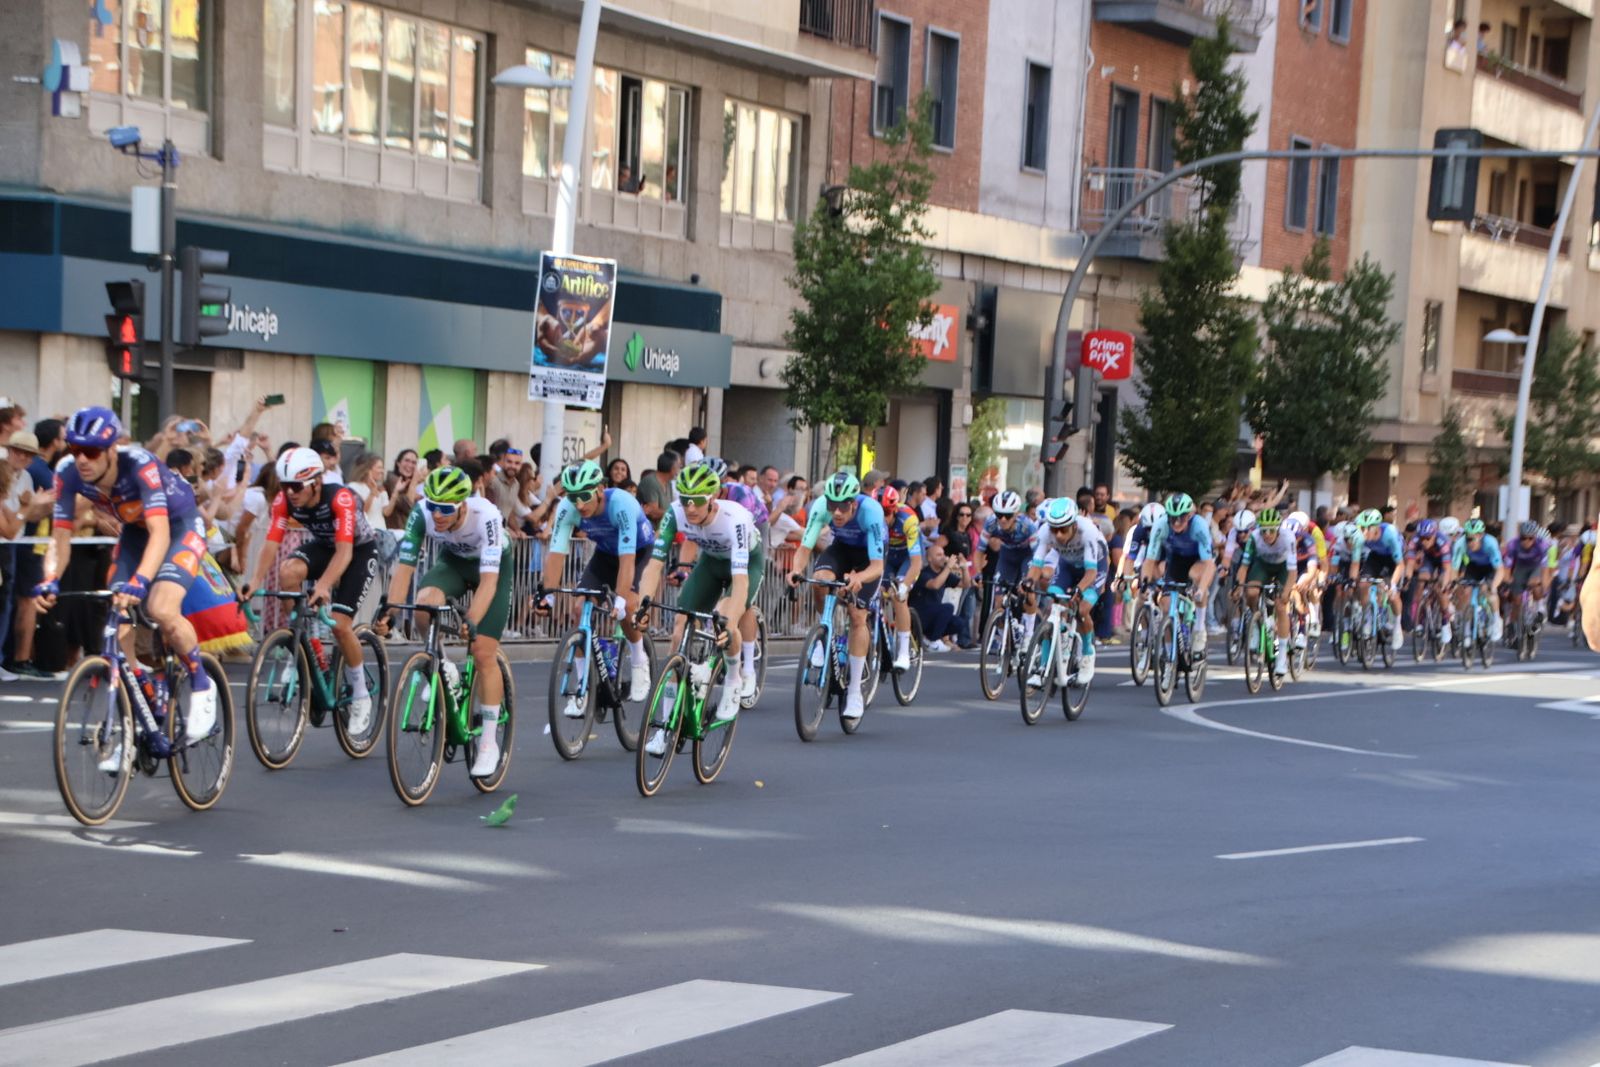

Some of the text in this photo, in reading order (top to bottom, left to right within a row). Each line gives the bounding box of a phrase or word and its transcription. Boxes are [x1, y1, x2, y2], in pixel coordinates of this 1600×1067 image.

[224, 303, 279, 341] Unicaja
[1090, 337, 1125, 351] Prima
[644, 347, 680, 378] Unicaja
[1089, 350, 1121, 372] PriX
[562, 436, 586, 464] 630
[485, 520, 494, 546] RGA
[735, 524, 744, 549] RGA
